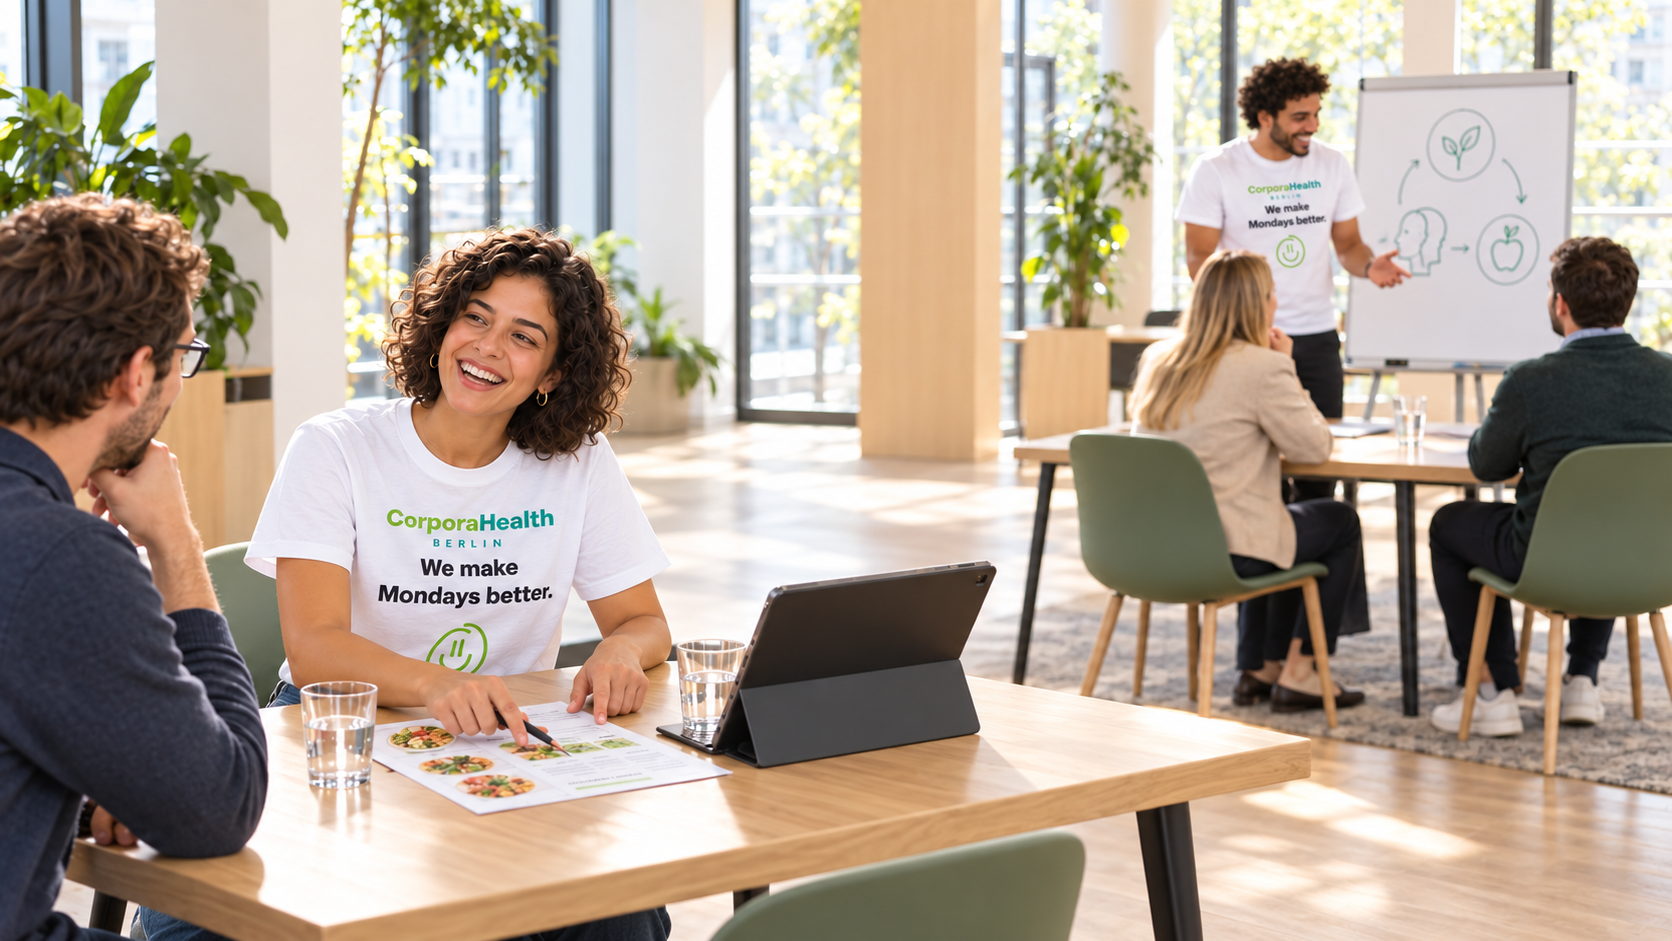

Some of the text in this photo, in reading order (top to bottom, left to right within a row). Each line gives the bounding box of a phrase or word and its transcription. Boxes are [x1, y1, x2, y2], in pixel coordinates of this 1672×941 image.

[1248, 180, 1321, 194] CorporaHealth
[1264, 202, 1310, 214] We make
[1248, 215, 1327, 229] Mondays better.
[386, 509, 555, 534] CorporaHealth
[433, 539, 502, 548] BERLIN
[421, 558, 519, 577] We make
[378, 584, 553, 608] Mondays better.
